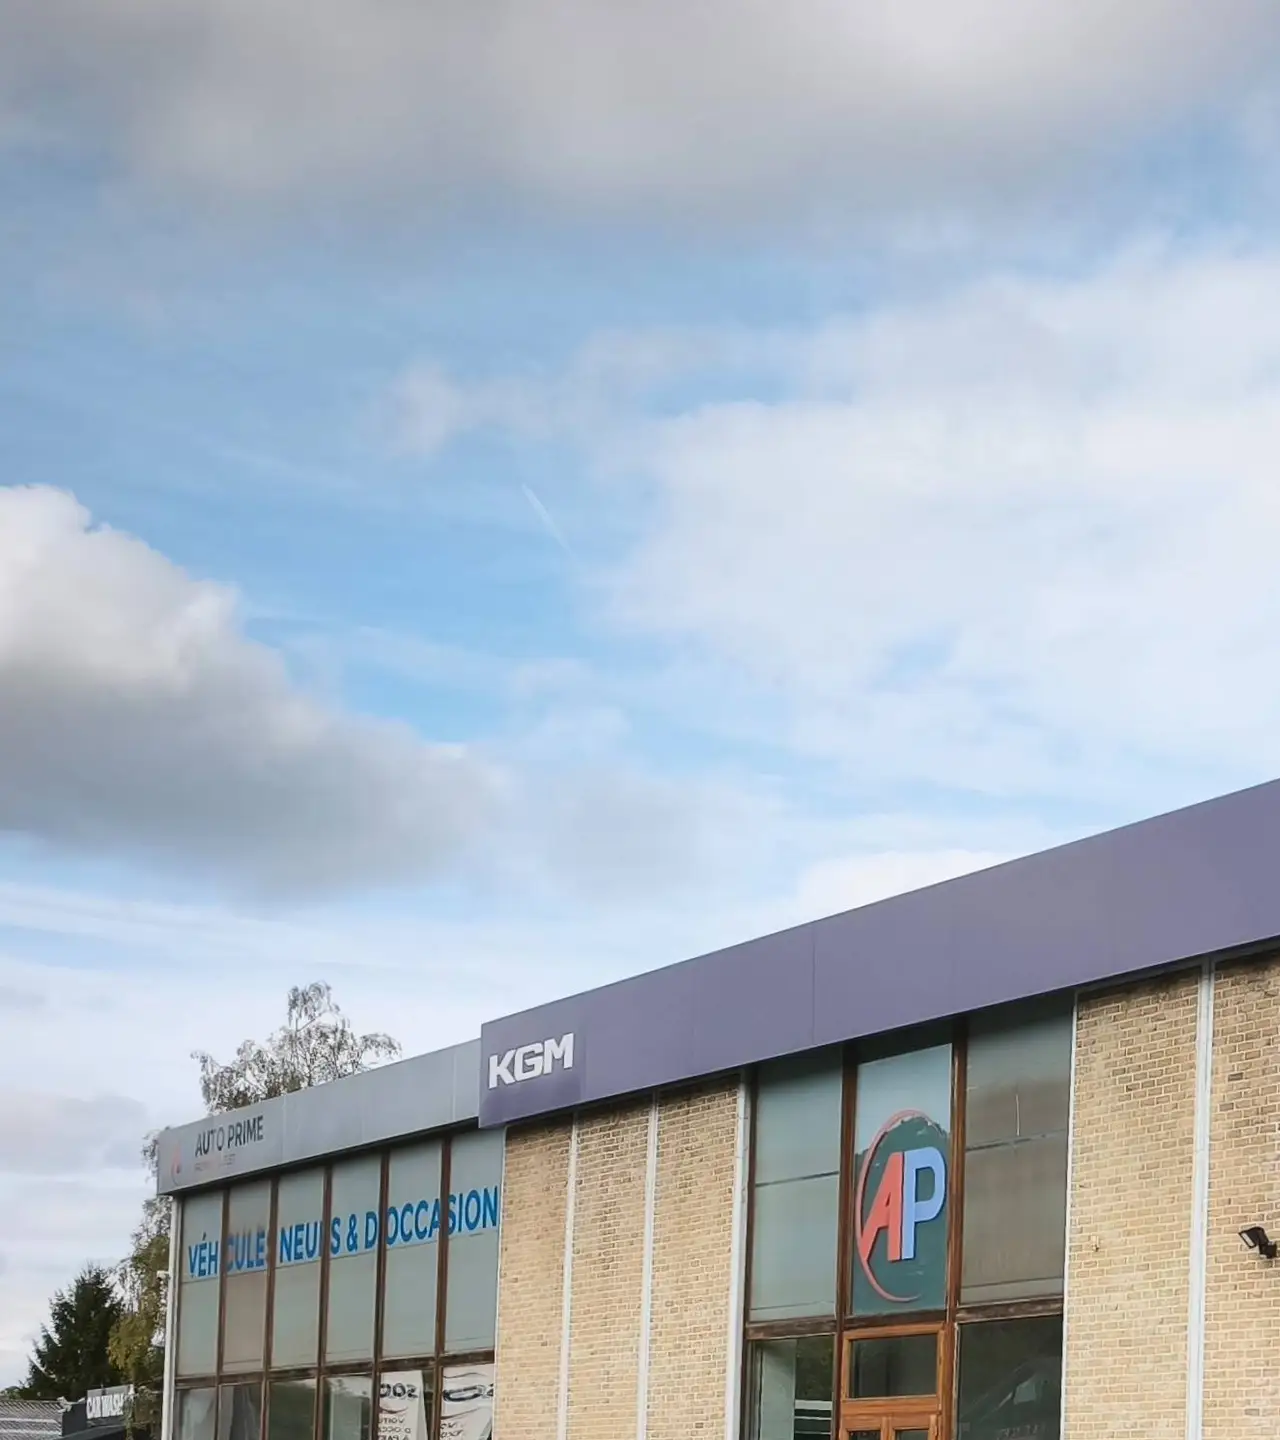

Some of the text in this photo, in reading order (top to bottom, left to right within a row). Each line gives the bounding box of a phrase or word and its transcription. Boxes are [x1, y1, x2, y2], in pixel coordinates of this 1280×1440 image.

[488, 1031, 575, 1090] KGM
[194, 1114, 264, 1158] AUTO PRIME
[188, 1185, 498, 1278] VÉHCULE NEUS & DOCCASION
[860, 1145, 946, 1263] AP
